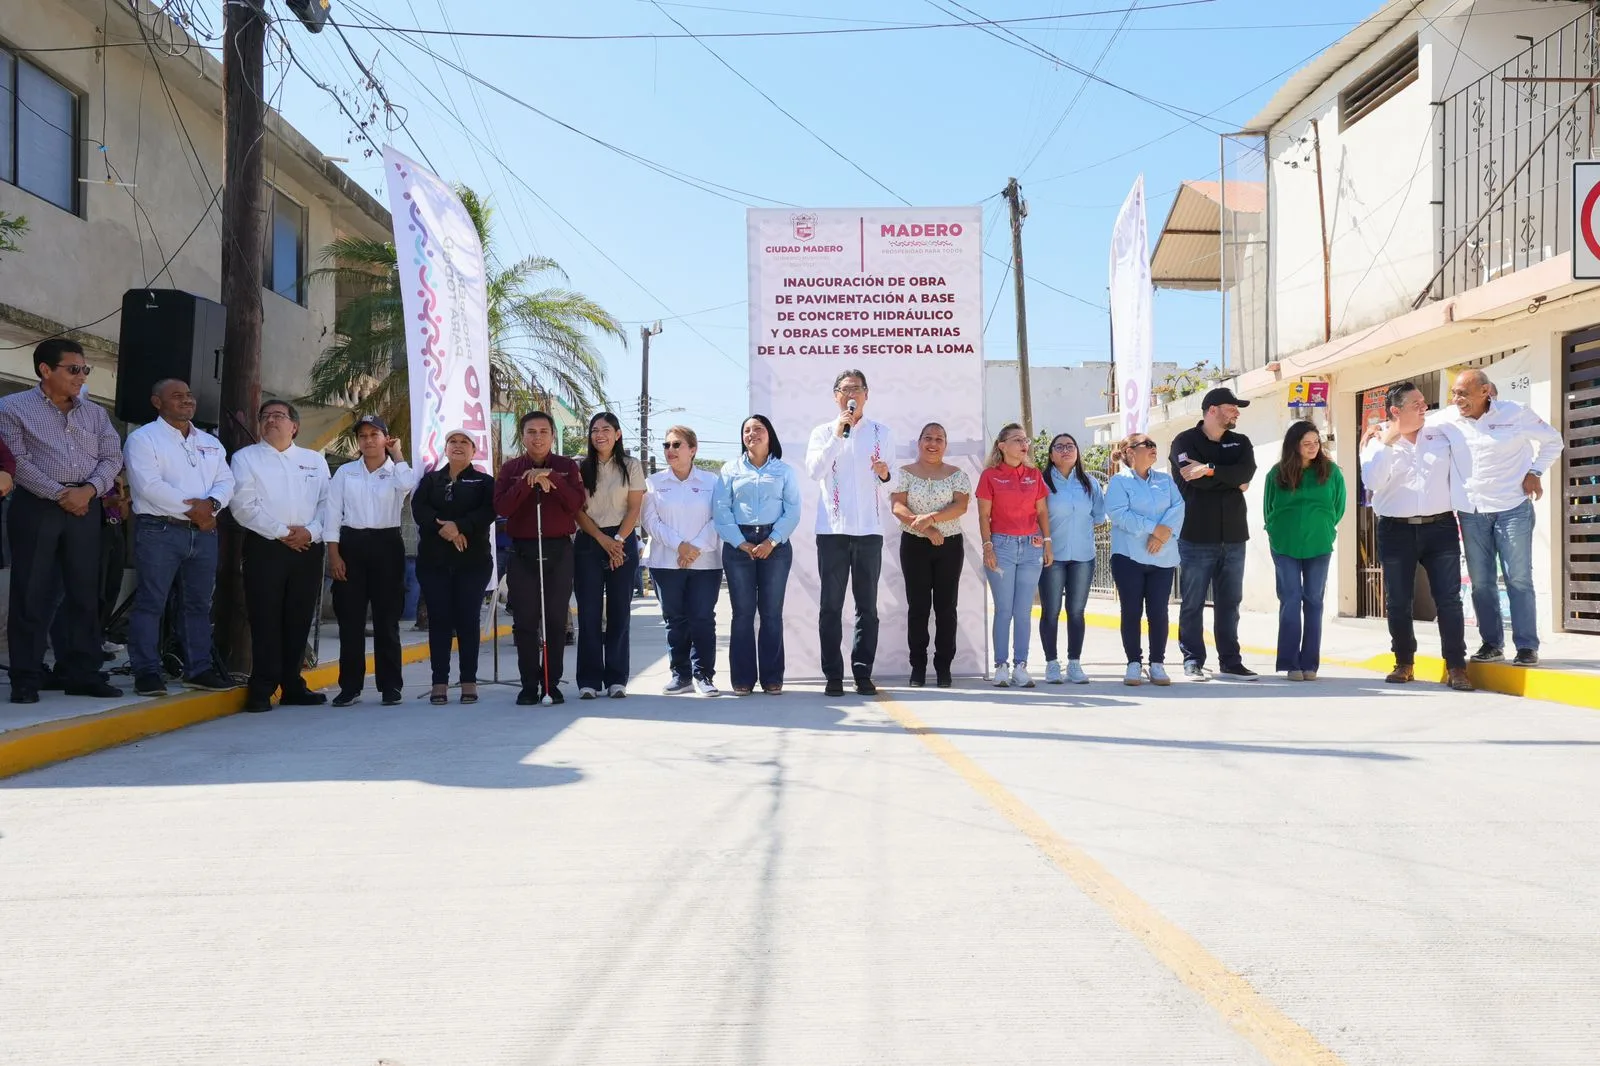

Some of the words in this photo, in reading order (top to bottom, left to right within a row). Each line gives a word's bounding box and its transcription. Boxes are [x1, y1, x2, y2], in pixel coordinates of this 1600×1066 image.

[881, 223, 963, 237] MADERO
[765, 245, 801, 253] CIUDAD
[803, 245, 844, 253] MADERO
[783, 274, 884, 288] INAUGURACIÓN
[888, 277, 905, 287] DE
[909, 276, 946, 287] OBRA
[775, 294, 793, 305] DE
[796, 291, 905, 305] PAVIMENTACIÓN
[908, 294, 917, 303] A
[921, 293, 955, 303] BASE
[777, 311, 795, 321] DE
[798, 310, 869, 321] CONCRETO
[873, 307, 953, 320] HIDRÁULICO
[771, 328, 779, 338] Y
[782, 327, 828, 338] OBRAS
[831, 327, 961, 338] COMPLEMENTARIAS
[757, 345, 775, 356] DE
[779, 345, 795, 355] LA
[799, 345, 840, 355] CALLE
[843, 344, 858, 355] 36
[862, 344, 912, 354] SECTOR
[916, 344, 933, 354] LA
[936, 343, 974, 354] LOMA
